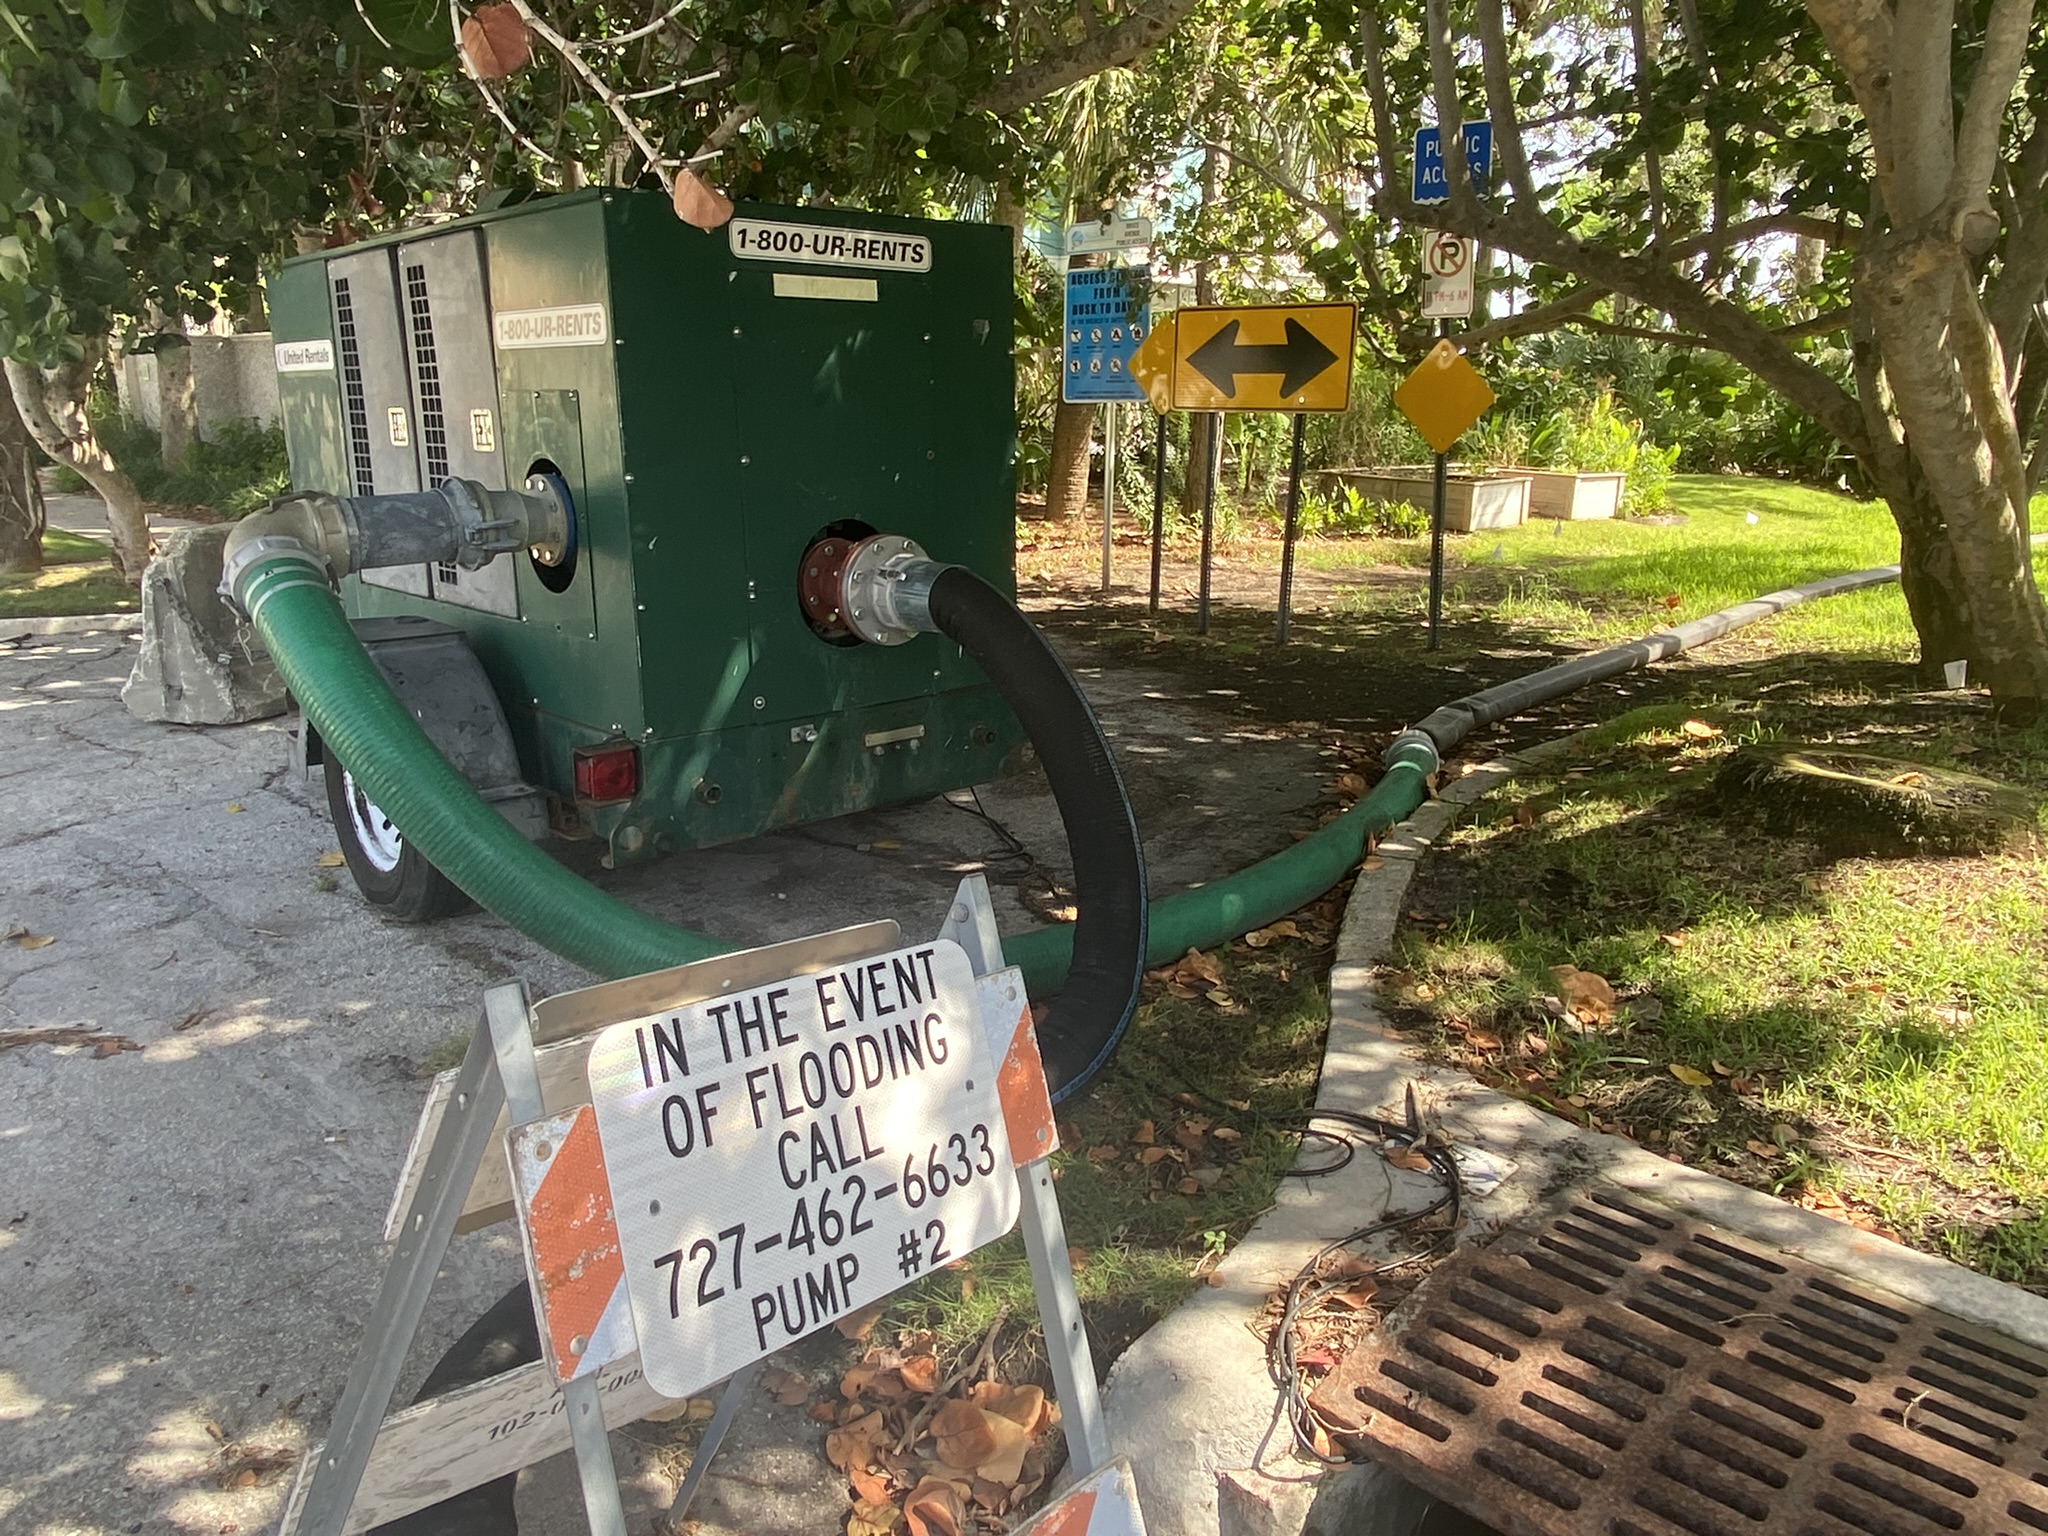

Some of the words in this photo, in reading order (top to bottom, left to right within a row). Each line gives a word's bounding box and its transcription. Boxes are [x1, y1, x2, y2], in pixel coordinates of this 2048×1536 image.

[1426, 135, 1480, 158] PUIC
[737, 228, 925, 263] 1-800-UR-RENTS
[1071, 272, 1107, 285] ACCESS
[1094, 287, 1120, 300] FROM
[1458, 290, 1468, 300] AM
[1072, 303, 1097, 315] DUSK
[1100, 302, 1111, 314] TO
[499, 312, 602, 340] 1-800-UR-RENTS
[284, 349, 304, 365] United
[305, 347, 329, 363] Rentals
[635, 1017, 690, 1088] IN
[707, 988, 799, 1063] THE
[815, 949, 937, 1032] EVENT
[662, 1082, 721, 1158] OF
[745, 1013, 949, 1129] FLOODING
[778, 1105, 885, 1190] CALL
[654, 1124, 996, 1320] 727-462-6633
[751, 1252, 860, 1351] PUMP
[898, 1219, 951, 1279] #2
